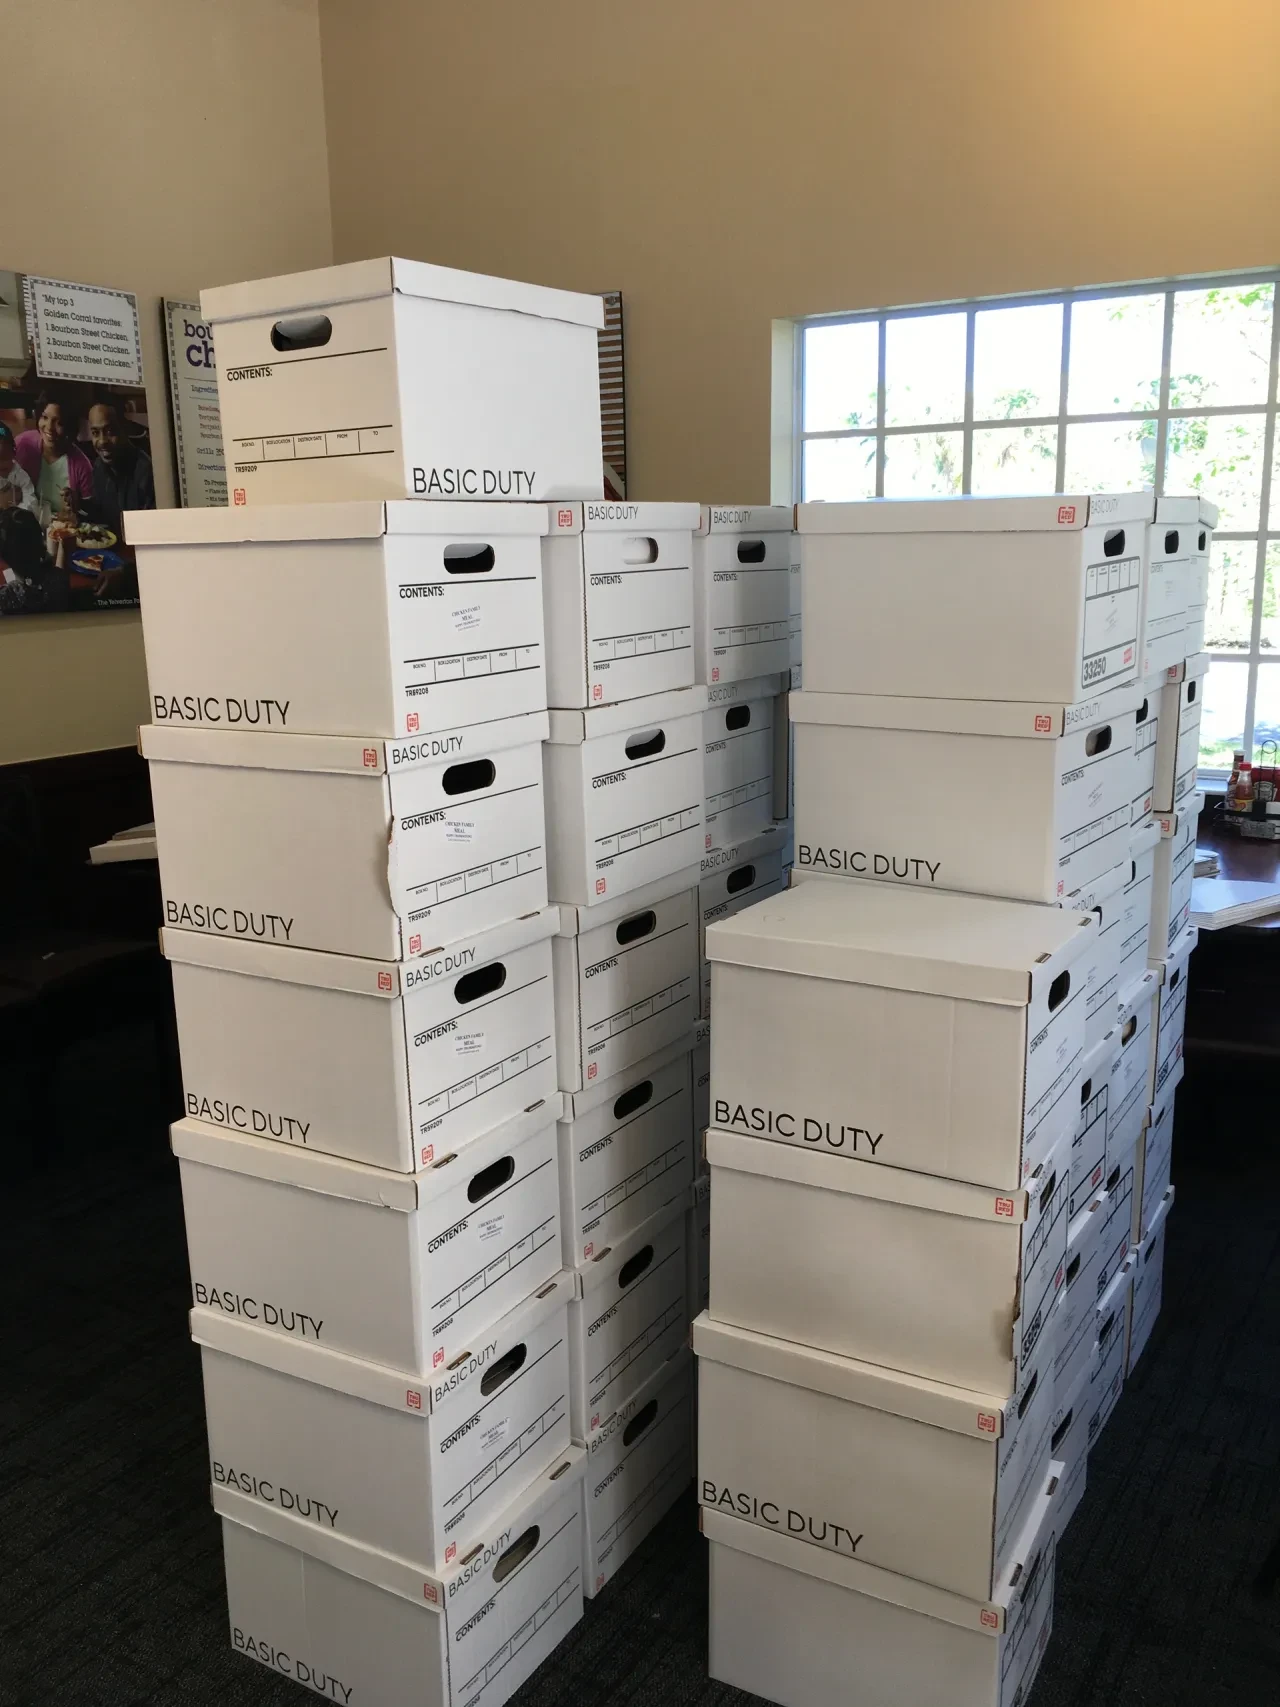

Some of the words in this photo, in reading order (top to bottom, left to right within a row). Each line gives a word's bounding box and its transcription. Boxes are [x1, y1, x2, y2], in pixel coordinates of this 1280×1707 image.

[57, 298, 68, 306] top
[44, 309, 69, 319] Golden
[71, 313, 91, 322] Corral
[81, 328, 99, 337] Street
[82, 342, 101, 351] Street
[84, 356, 102, 365] Street
[227, 367, 273, 381] CONTENTS:
[413, 468, 477, 494] BASIC
[483, 470, 535, 494] DUTY
[588, 506, 615, 520] BASIC
[616, 506, 638, 520] DUTY
[714, 511, 733, 523] BASIC
[734, 511, 751, 523] DUTY
[590, 575, 622, 586] CONTENTS:
[714, 573, 737, 582] CONTENTS:
[399, 586, 444, 599] CONTENTS:
[1083, 656, 1106, 681] 33250
[154, 695, 221, 722] BASIC
[226, 698, 290, 725] DUTY
[1067, 706, 1084, 726] BASIC
[1085, 702, 1100, 719] DUTY
[393, 743, 429, 764] BASIC
[431, 736, 463, 756] DUTY
[592, 772, 626, 789] CONTENTS:
[401, 811, 446, 831] CONTENTS:
[701, 854, 720, 871] BASIC
[722, 848, 739, 863] DUTY
[799, 845, 867, 872] BASIC
[874, 854, 940, 882] DUTY
[166, 900, 228, 930] BASIC
[234, 910, 294, 940] DUTY
[406, 961, 442, 988] BASIC
[445, 947, 476, 972] DUTY
[585, 958, 619, 979] CONTENTS:
[414, 1021, 458, 1047] CONTENTS:
[696, 1026, 710, 1042] BAS
[187, 1093, 247, 1127] BASIC
[252, 1109, 310, 1143] DUTY
[715, 1100, 795, 1137] BASIC
[804, 1118, 884, 1155] DUTY
[580, 1136, 614, 1162] CONTENTS:
[428, 1220, 469, 1253] CONTENTS:
[195, 1282, 258, 1319] BASIC
[264, 1303, 323, 1339] DUTY
[588, 1306, 618, 1337] CONTENTS:
[435, 1366, 468, 1403] BASIC
[470, 1341, 498, 1373] DUTY
[440, 1414, 481, 1454] CONTENTS:
[591, 1423, 616, 1453] BASIC
[617, 1400, 636, 1426] DUTY
[213, 1461, 274, 1502] BASIC
[280, 1488, 338, 1528] DUTY
[703, 1480, 779, 1524] BASIC
[788, 1510, 863, 1552] DUTY
[448, 1558, 482, 1597] BASIC
[484, 1528, 512, 1565] DUTY
[455, 1598, 496, 1642] CONTENTS:
[234, 1628, 291, 1672] BASIC
[297, 1660, 352, 1704] DUTY
